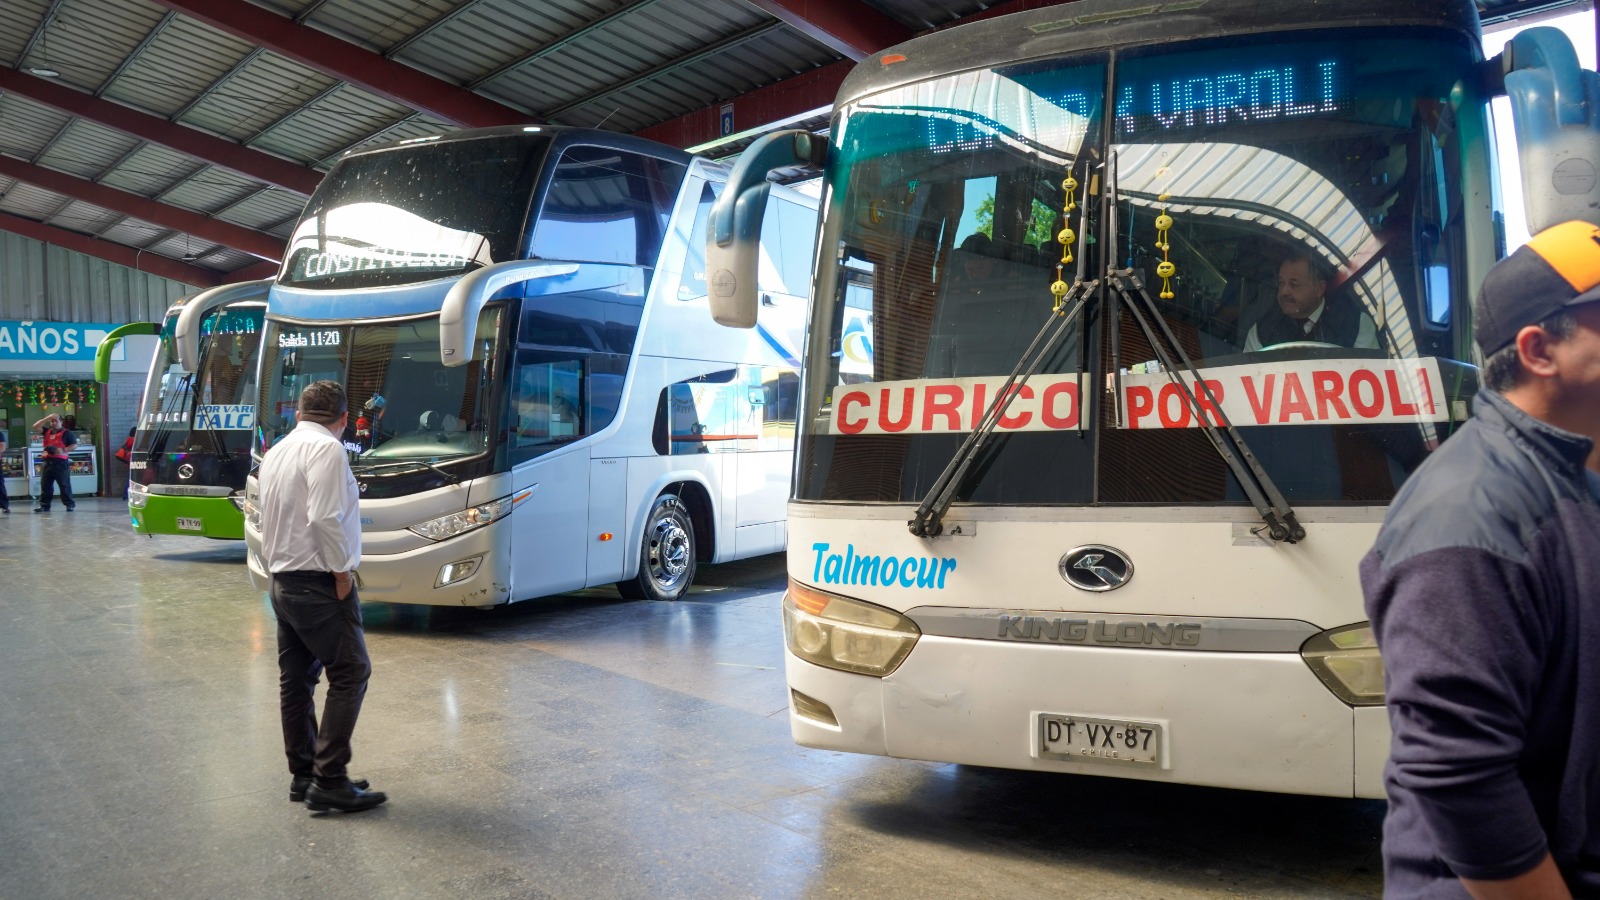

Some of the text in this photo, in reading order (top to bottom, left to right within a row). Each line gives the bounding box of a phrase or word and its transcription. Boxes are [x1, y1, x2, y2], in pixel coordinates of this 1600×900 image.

[1152, 62, 1338, 128] VAROLI
[724, 116, 730, 134] 8
[279, 331, 340, 347] Salida 11:20
[197, 405, 220, 413] POR
[837, 382, 1084, 435] CURICO
[1126, 368, 1436, 430] POR VAROLI
[196, 414, 254, 429] TALC
[812, 543, 957, 589] Talmocur
[998, 615, 1202, 647] KING LONG
[1080, 748, 1119, 758] CHILE
